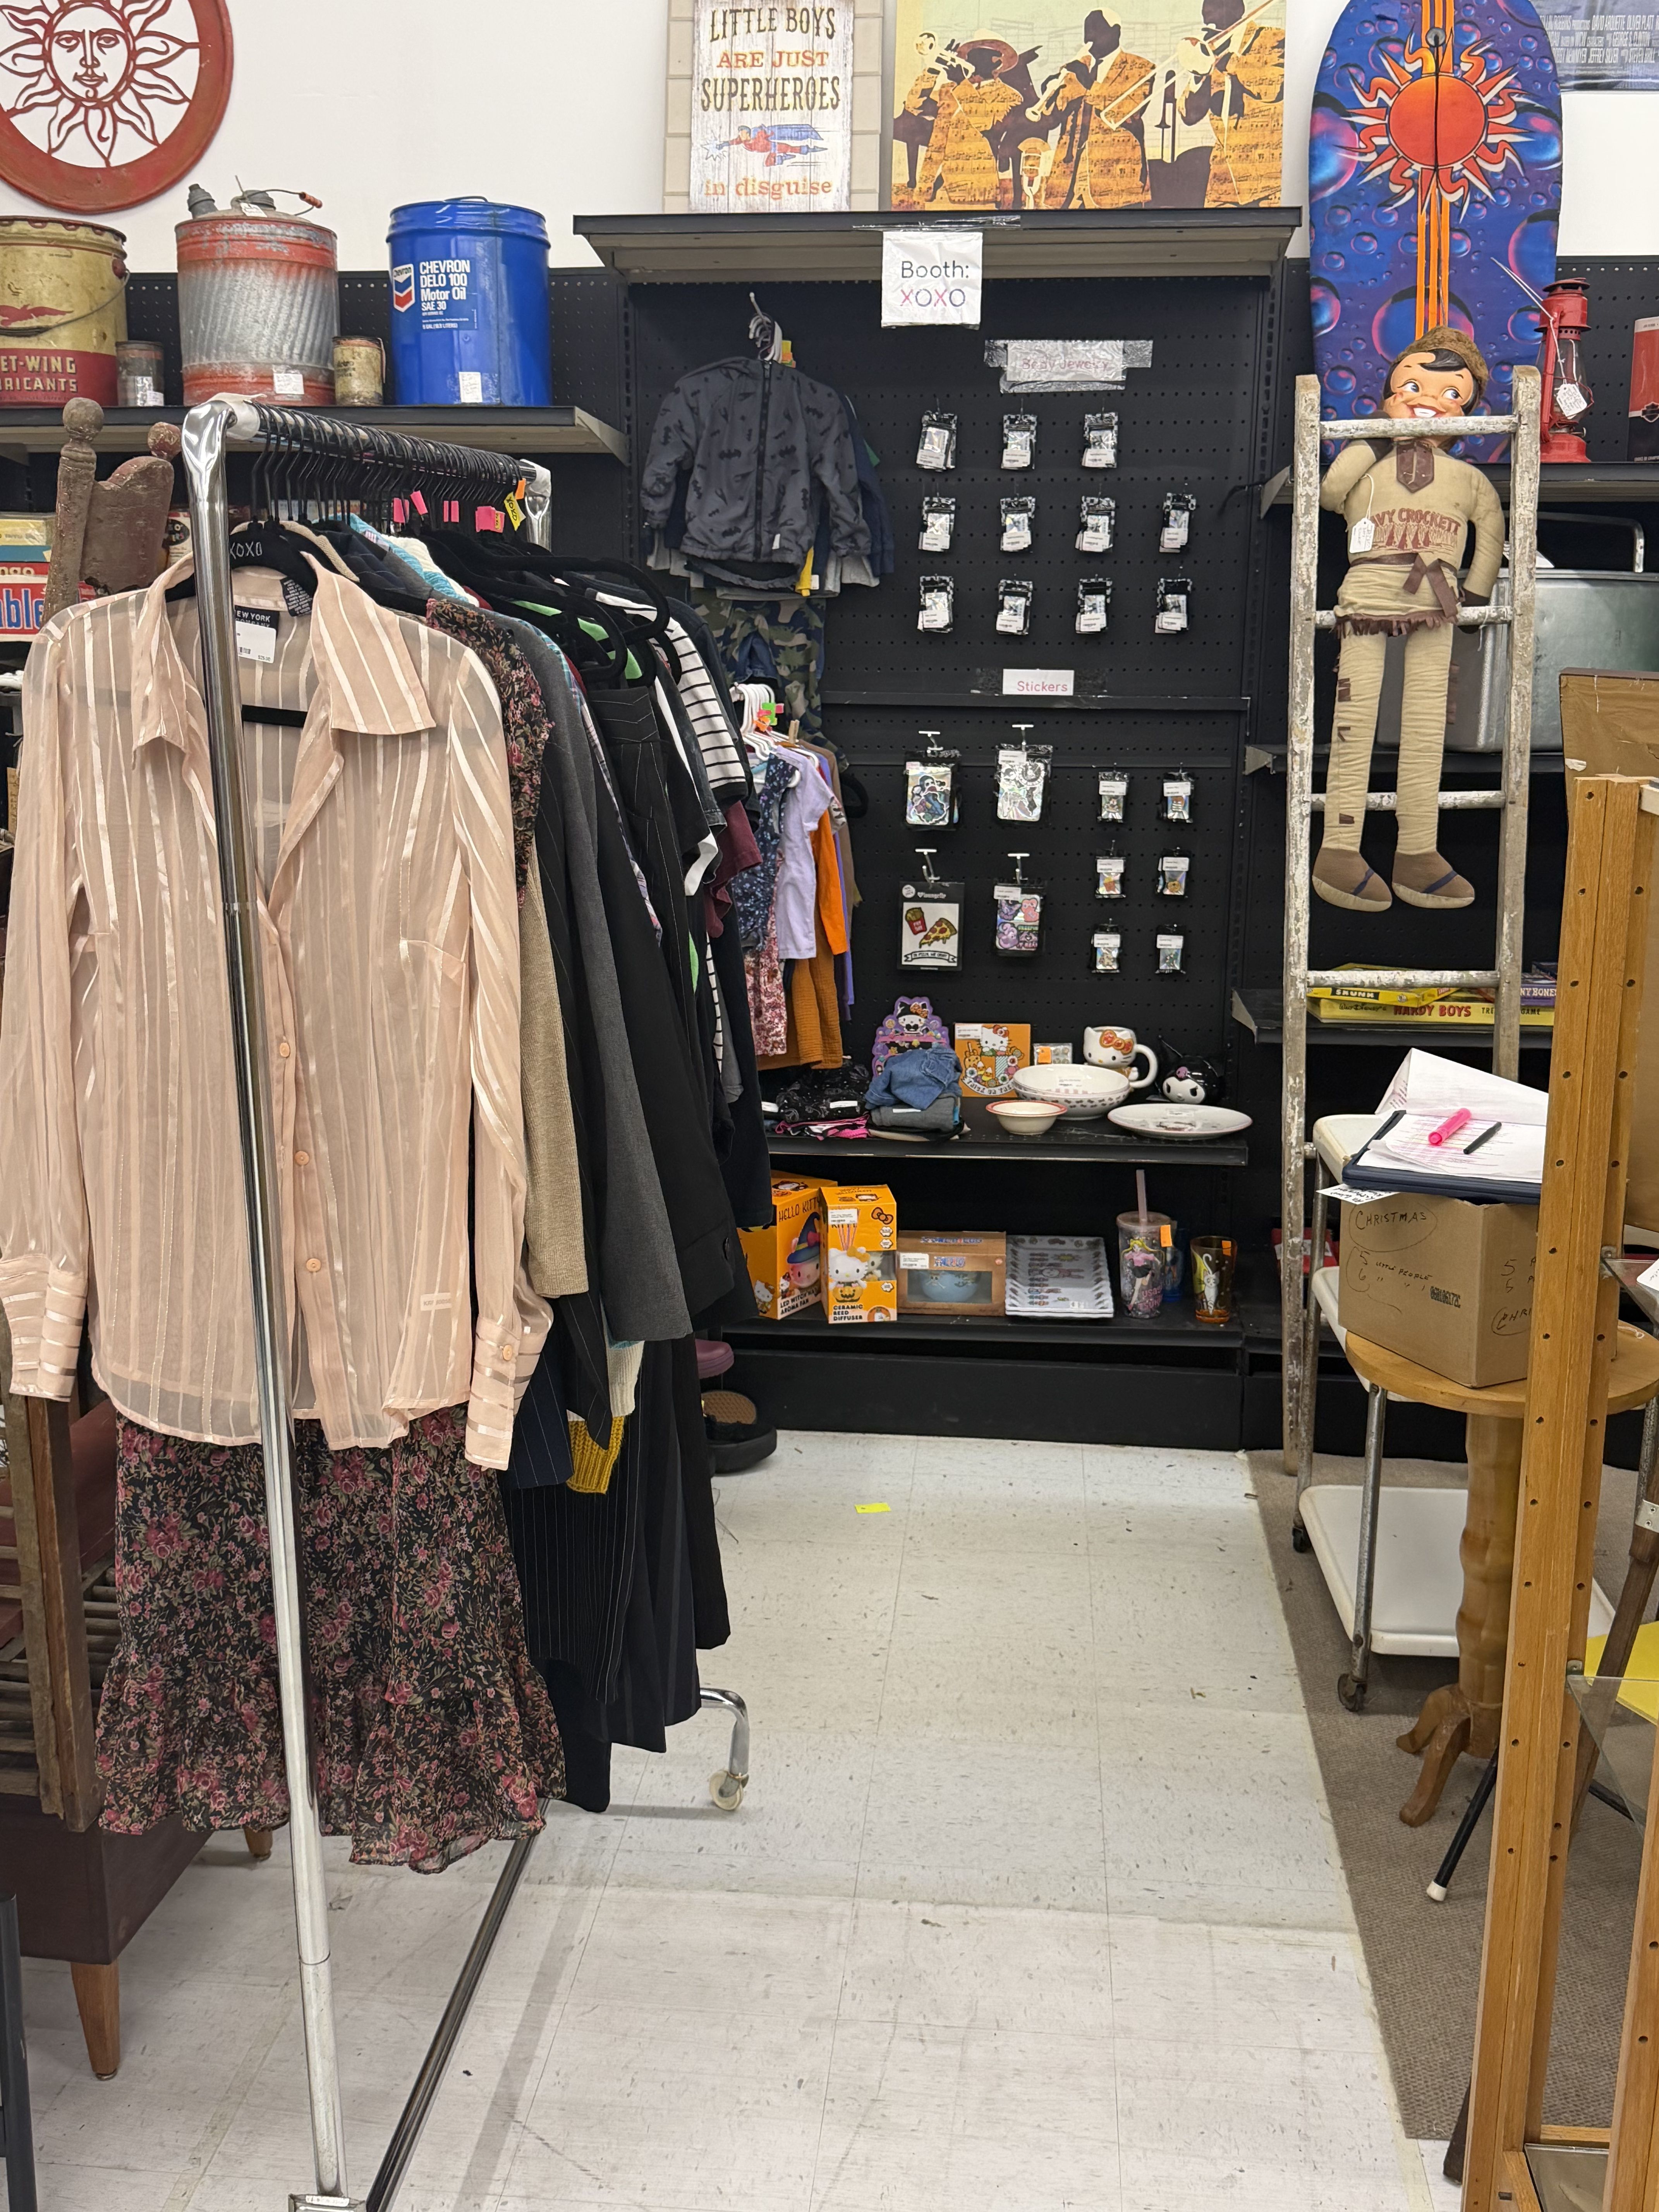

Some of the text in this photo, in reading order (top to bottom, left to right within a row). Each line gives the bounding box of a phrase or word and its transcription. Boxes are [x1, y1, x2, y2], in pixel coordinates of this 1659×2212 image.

[710, 7, 836, 42] LITTLE BOYS
[716, 51, 829, 68] ARE JUST
[701, 76, 840, 112] SUPERHEROES
[704, 176, 832, 201] in disguise
[420, 260, 470, 275] CHEVRON
[902, 260, 969, 278] Booth:
[421, 273, 467, 288] DELO 100
[421, 287, 467, 302] Motor Oil
[900, 289, 965, 307] XOXO
[422, 301, 447, 311] SAE 30
[0, 355, 76, 374] ET-WING
[1370, 507, 1461, 536] AVY CROCKETT
[0, 588, 45, 630] ble
[234, 610, 271, 623] EW YORK
[1017, 680, 1068, 692] Stickers
[1336, 989, 1374, 998] SKUNK
[1520, 988, 1531, 996] NY
[1394, 1005, 1434, 1017] HARDY
[1439, 1005, 1472, 1017] BOYS
[779, 1204, 800, 1222] HELLO
[1356, 1211, 1427, 1230] CHRISTMAS
[1359, 1251, 1370, 1265] 5
[1398, 1268, 1433, 1280] PEOPLE
[1501, 1259, 1518, 1276] 5
[780, 1299, 790, 1308] LED
[781, 1298, 809, 1315] AROMA FAN
[1496, 1307, 1532, 1330] CHRI
